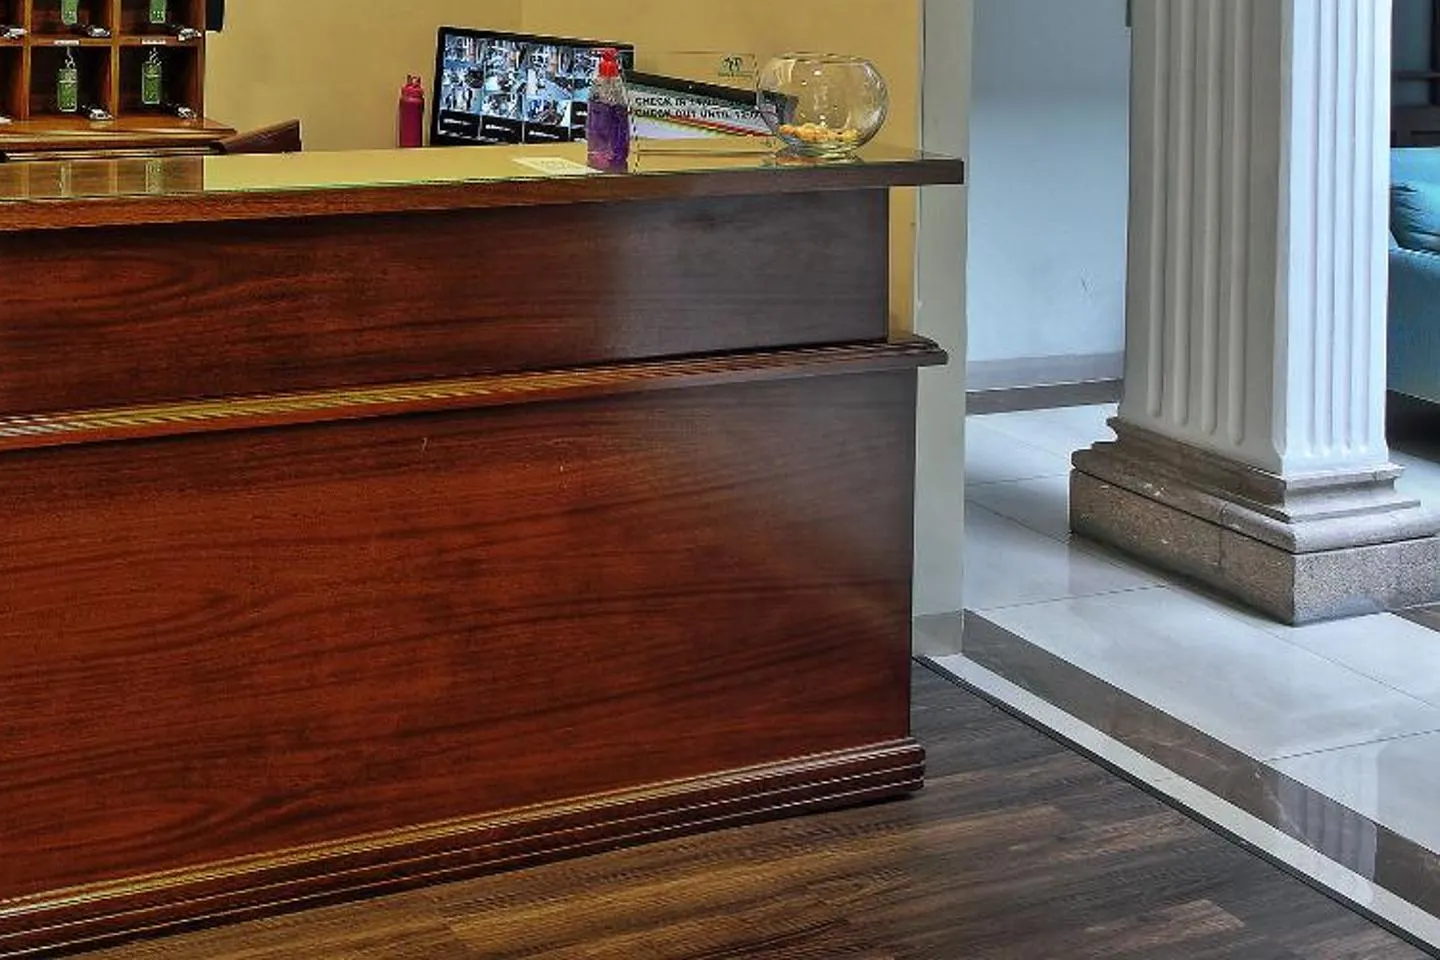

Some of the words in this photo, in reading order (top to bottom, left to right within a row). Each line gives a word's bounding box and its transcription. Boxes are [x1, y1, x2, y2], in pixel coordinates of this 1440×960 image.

[635, 97, 672, 107] CHECK
[635, 109, 671, 117] CHECK
[675, 109, 695, 118] OUT
